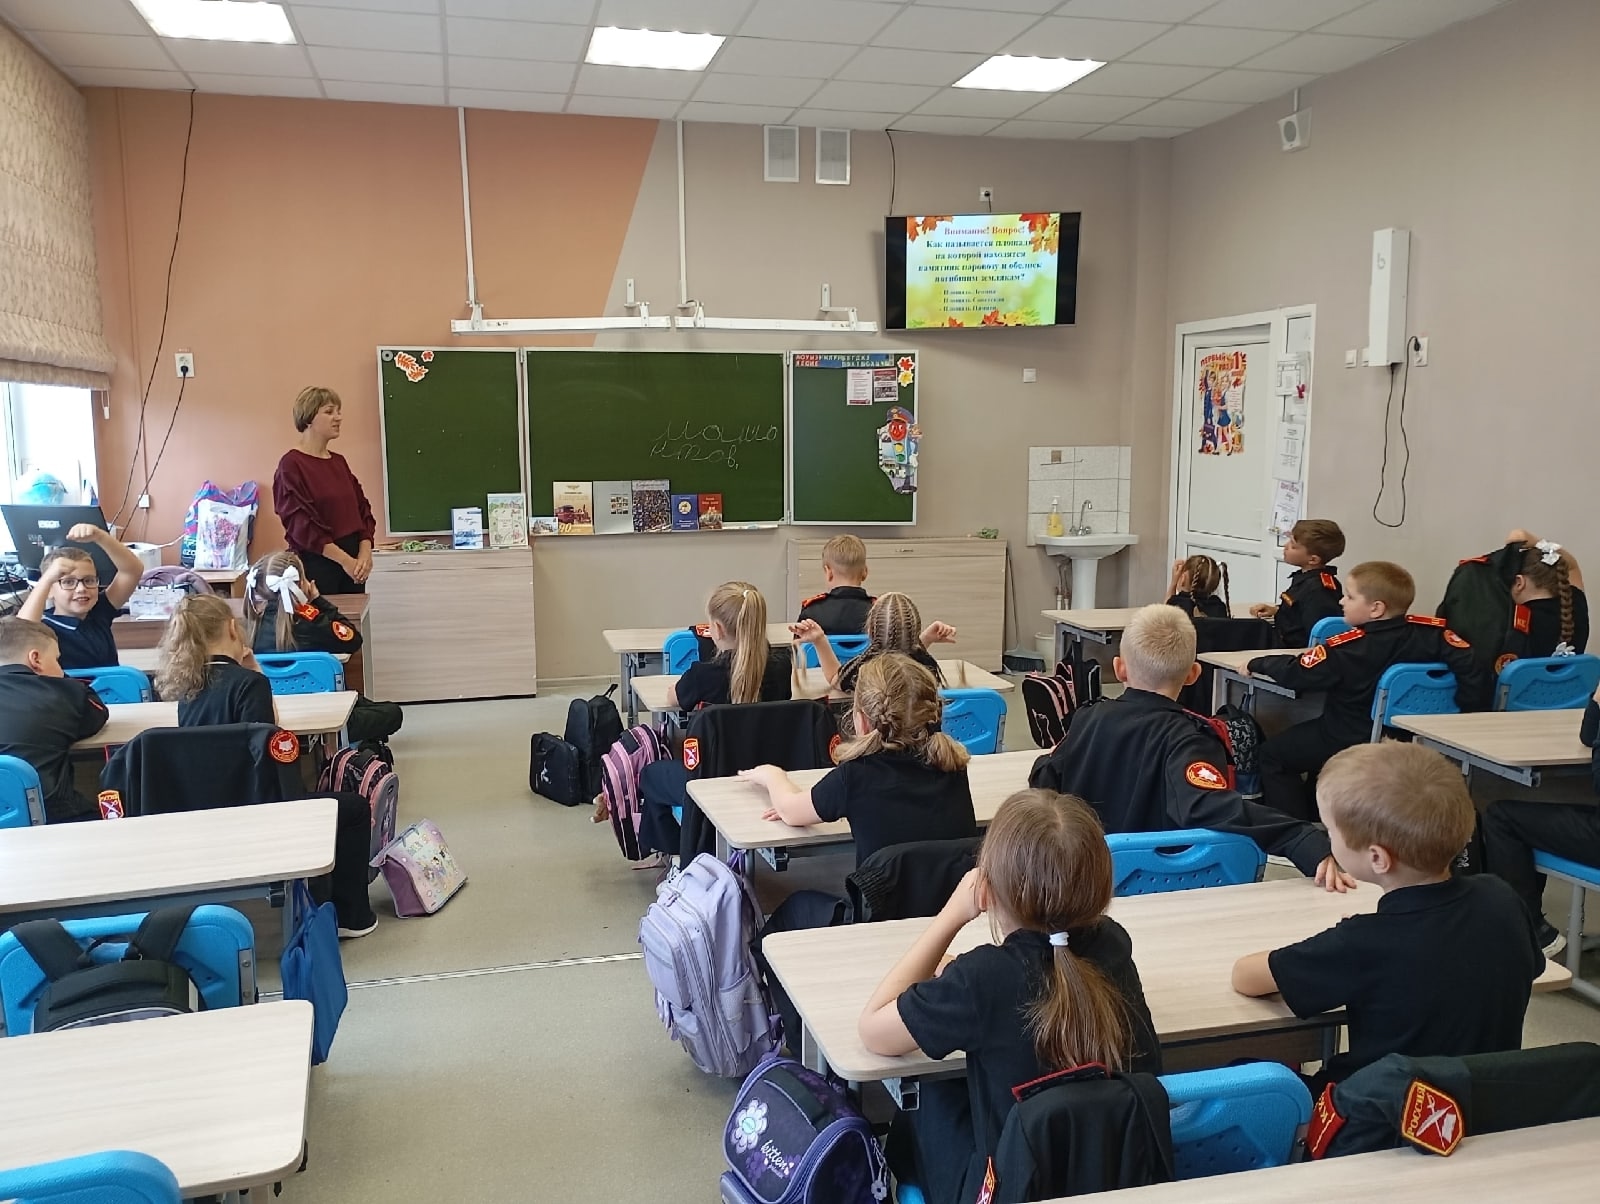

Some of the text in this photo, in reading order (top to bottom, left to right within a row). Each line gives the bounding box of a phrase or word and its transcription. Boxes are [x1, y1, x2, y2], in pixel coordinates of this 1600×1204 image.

[992, 225, 1025, 236] Вопрос!
[926, 240, 943, 248] Как
[947, 251, 982, 261] которой
[983, 250, 1026, 259] находятся
[1406, 1085, 1427, 1137] РОССИЯ
